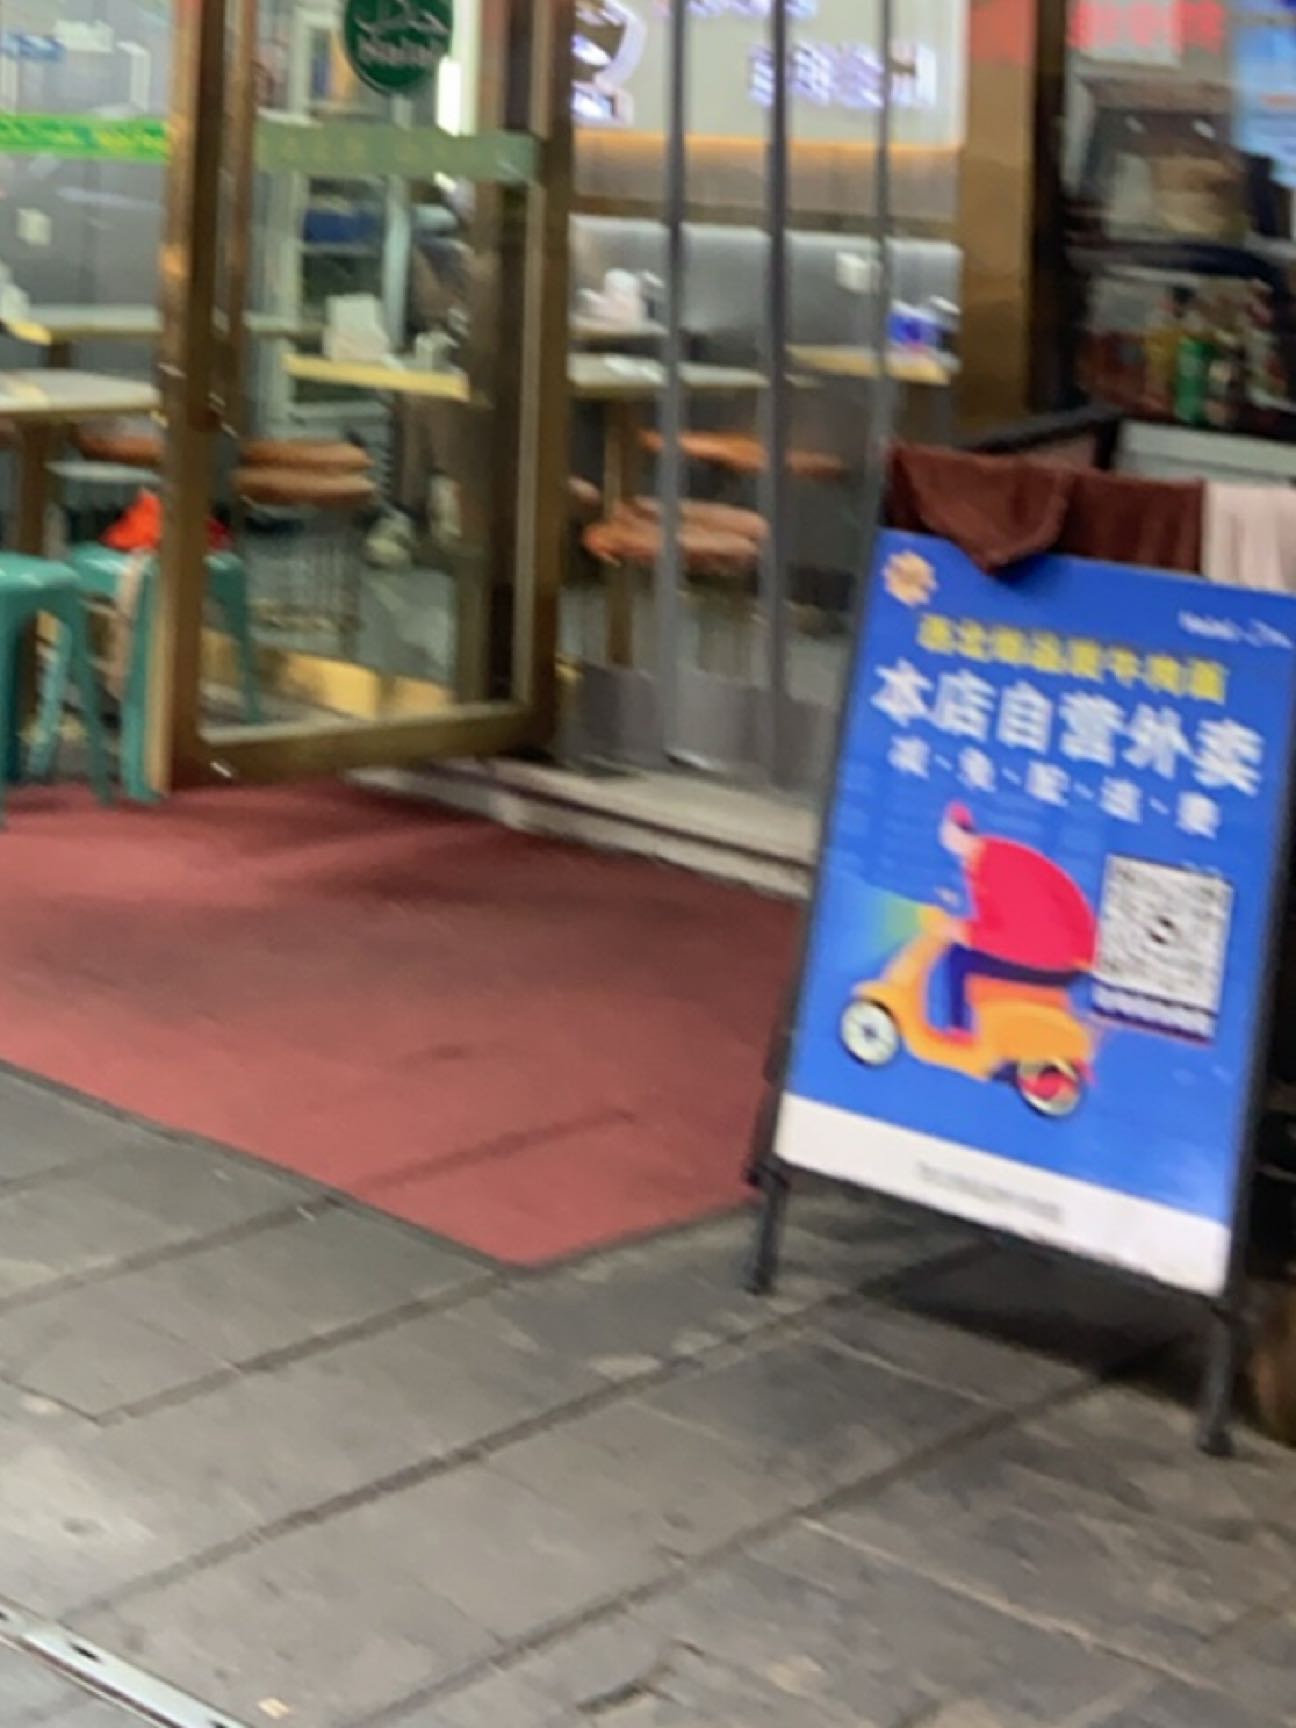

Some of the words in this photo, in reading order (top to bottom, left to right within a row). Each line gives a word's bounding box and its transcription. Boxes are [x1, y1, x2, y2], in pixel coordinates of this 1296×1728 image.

[871, 657, 1264, 798] 本店自营外卖
